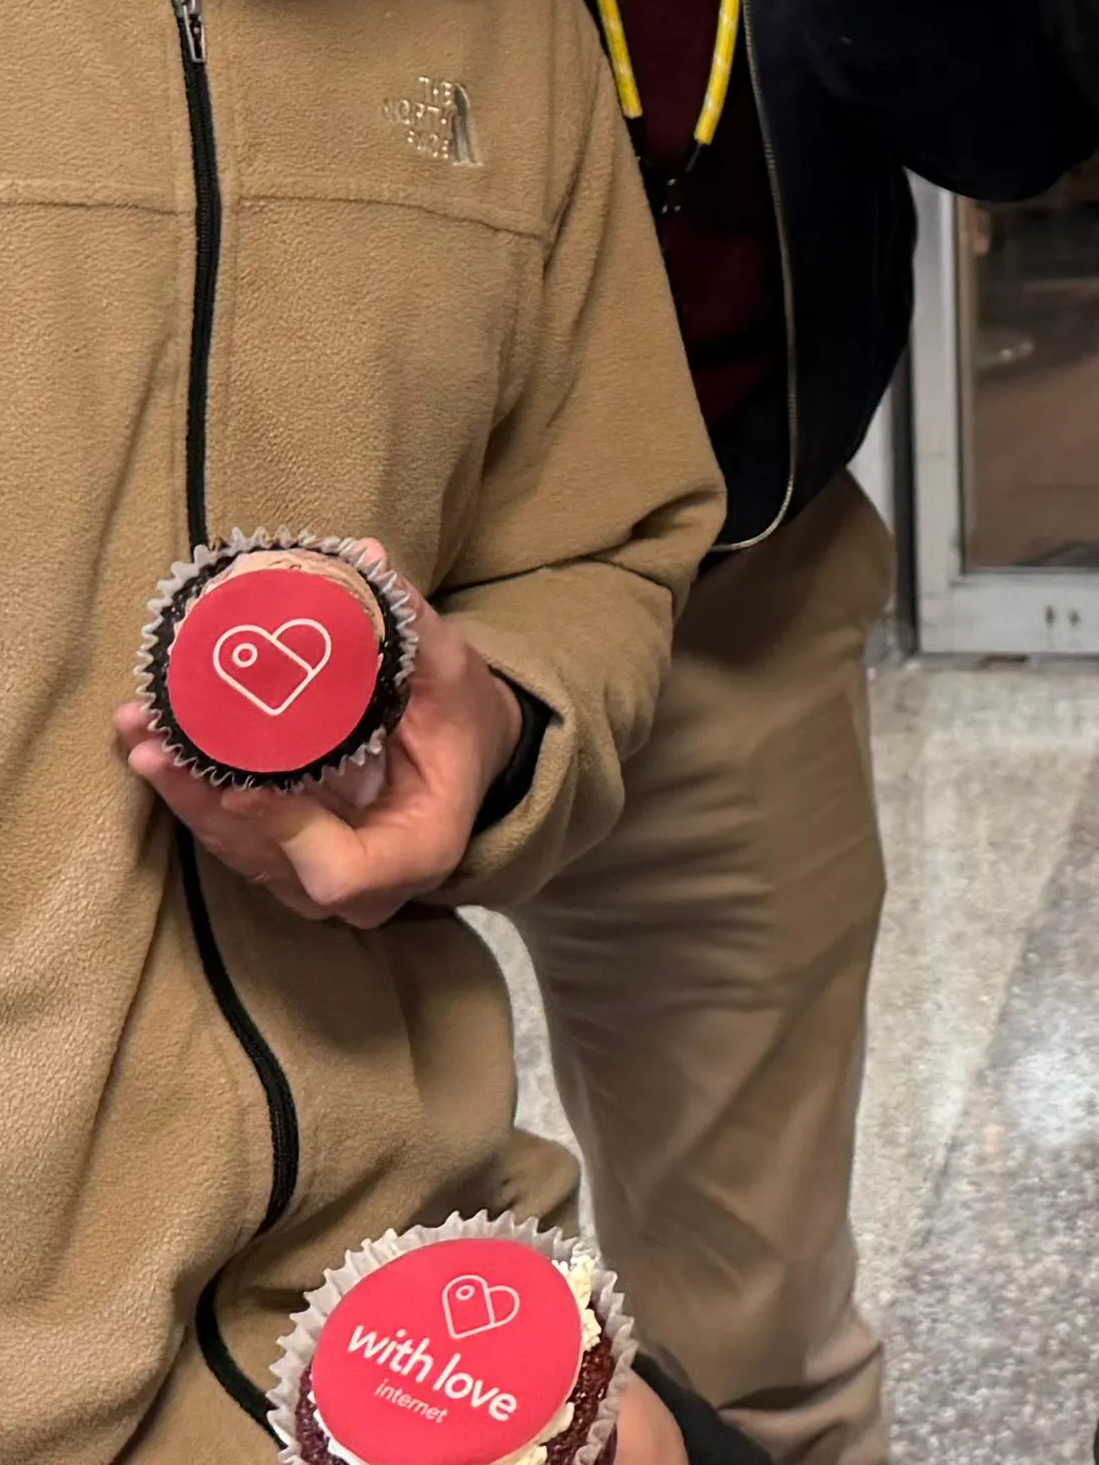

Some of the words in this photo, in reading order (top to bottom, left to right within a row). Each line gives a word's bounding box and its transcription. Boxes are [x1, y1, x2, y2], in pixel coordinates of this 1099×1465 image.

[347, 1324, 434, 1383] with
[433, 1353, 518, 1422] love
[374, 1378, 448, 1424] internet
